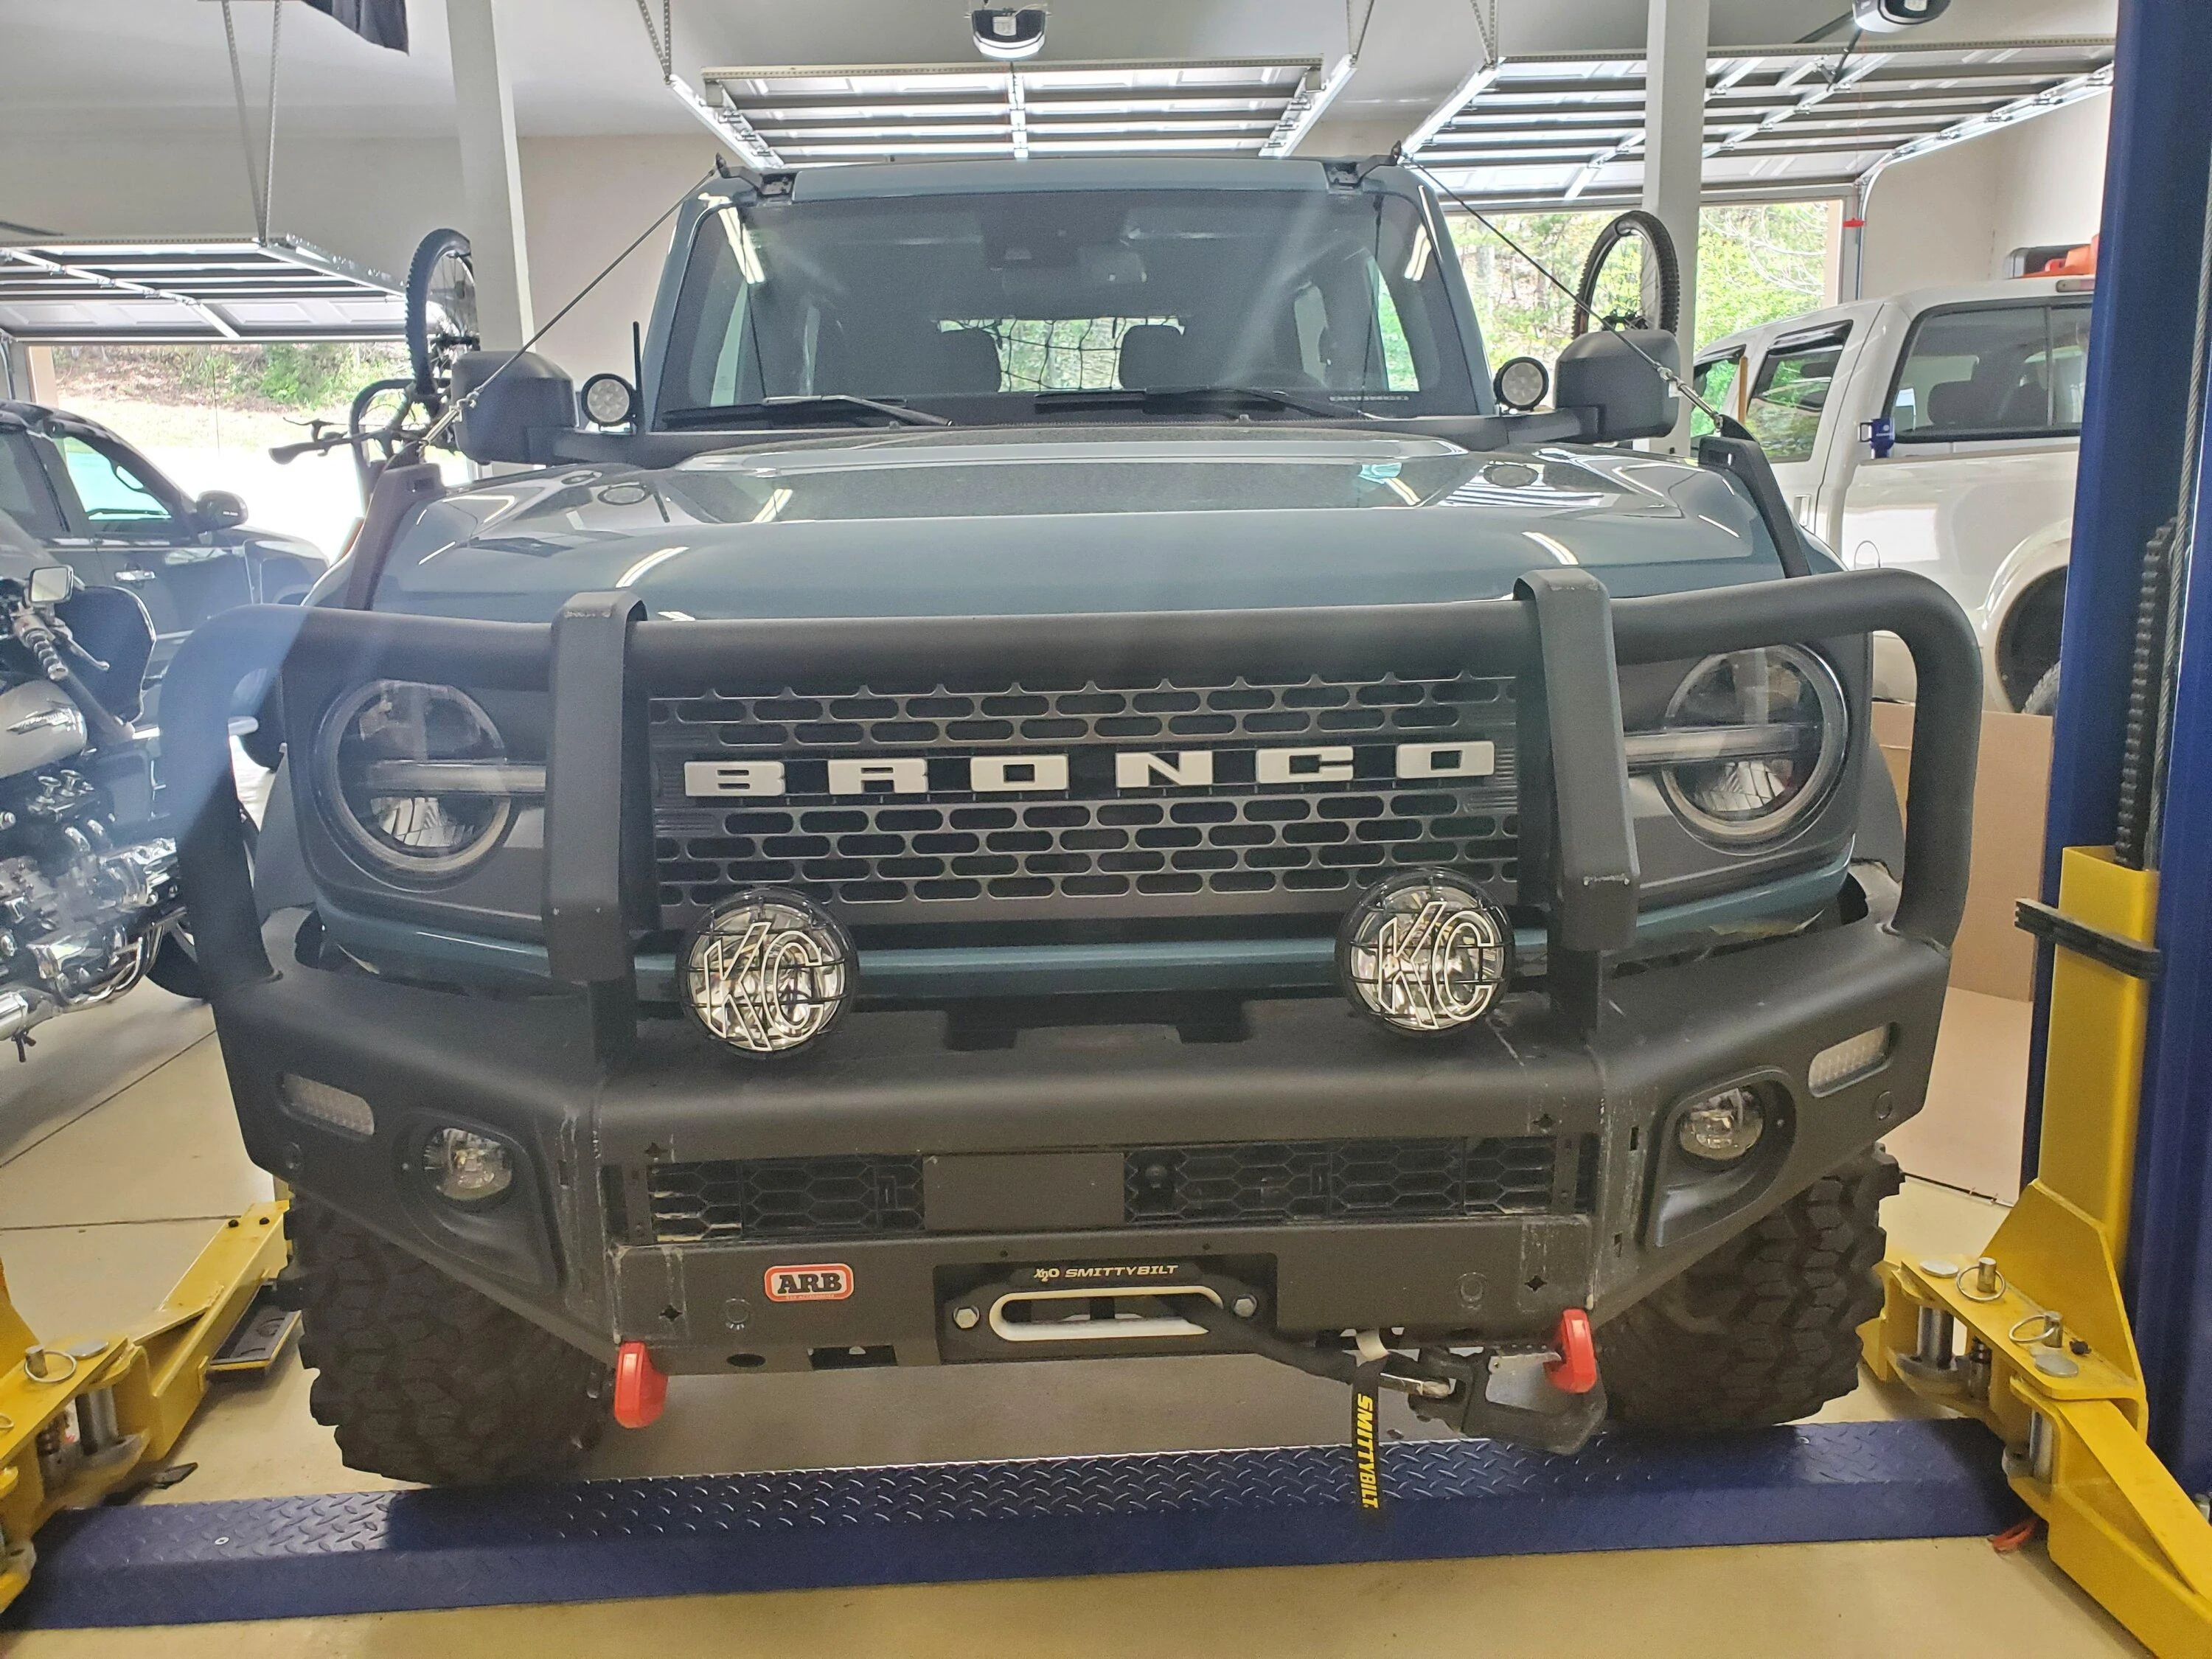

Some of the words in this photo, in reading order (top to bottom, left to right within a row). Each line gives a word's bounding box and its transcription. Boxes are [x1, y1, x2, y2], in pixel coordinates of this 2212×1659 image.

[684, 741, 1495, 796] BRONCO
[704, 922, 824, 1051] KC
[1377, 901, 1495, 1029] KC
[777, 1273, 842, 1294] ARB
[1065, 1265, 1178, 1278] SMITTYBILT
[1357, 1394, 1379, 1509] SMITTYBILT
